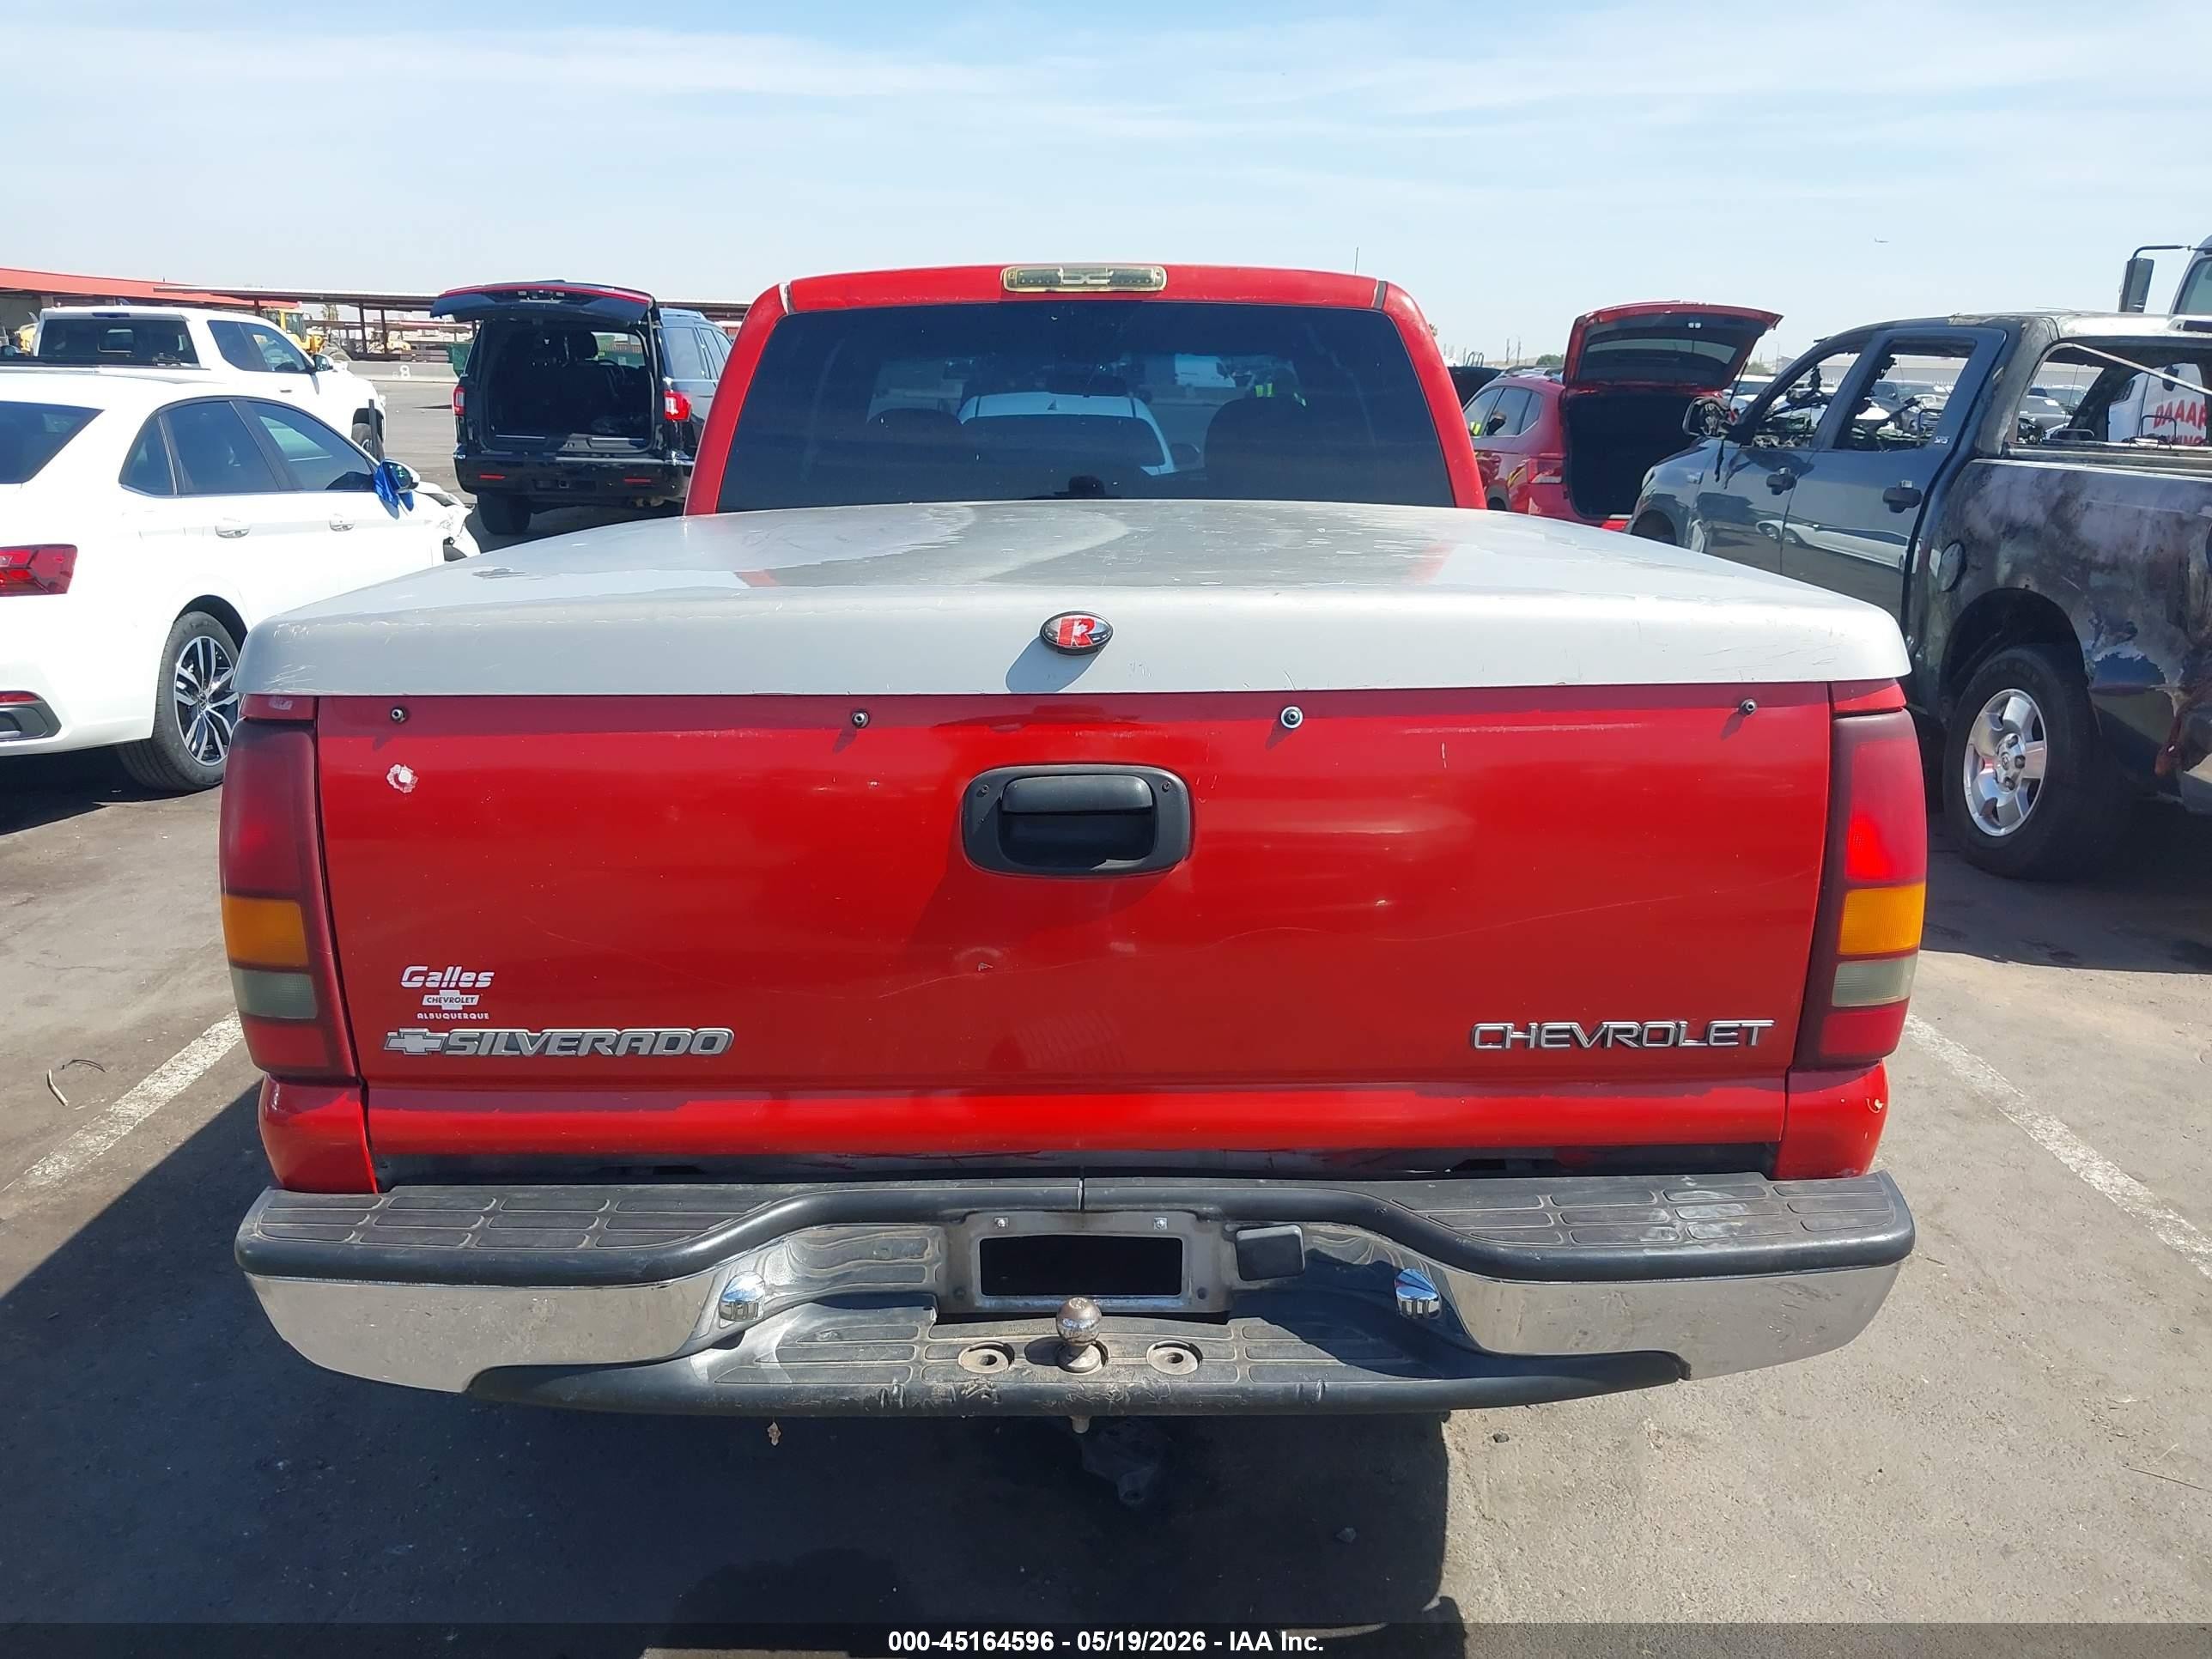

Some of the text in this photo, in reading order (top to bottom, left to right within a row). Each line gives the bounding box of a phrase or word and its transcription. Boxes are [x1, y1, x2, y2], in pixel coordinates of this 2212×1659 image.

[1056, 616, 1097, 647] R
[400, 965, 495, 988] Galles
[444, 1028, 735, 1056] SILVERADO
[1471, 1019, 1776, 1049] CHEVROLET
